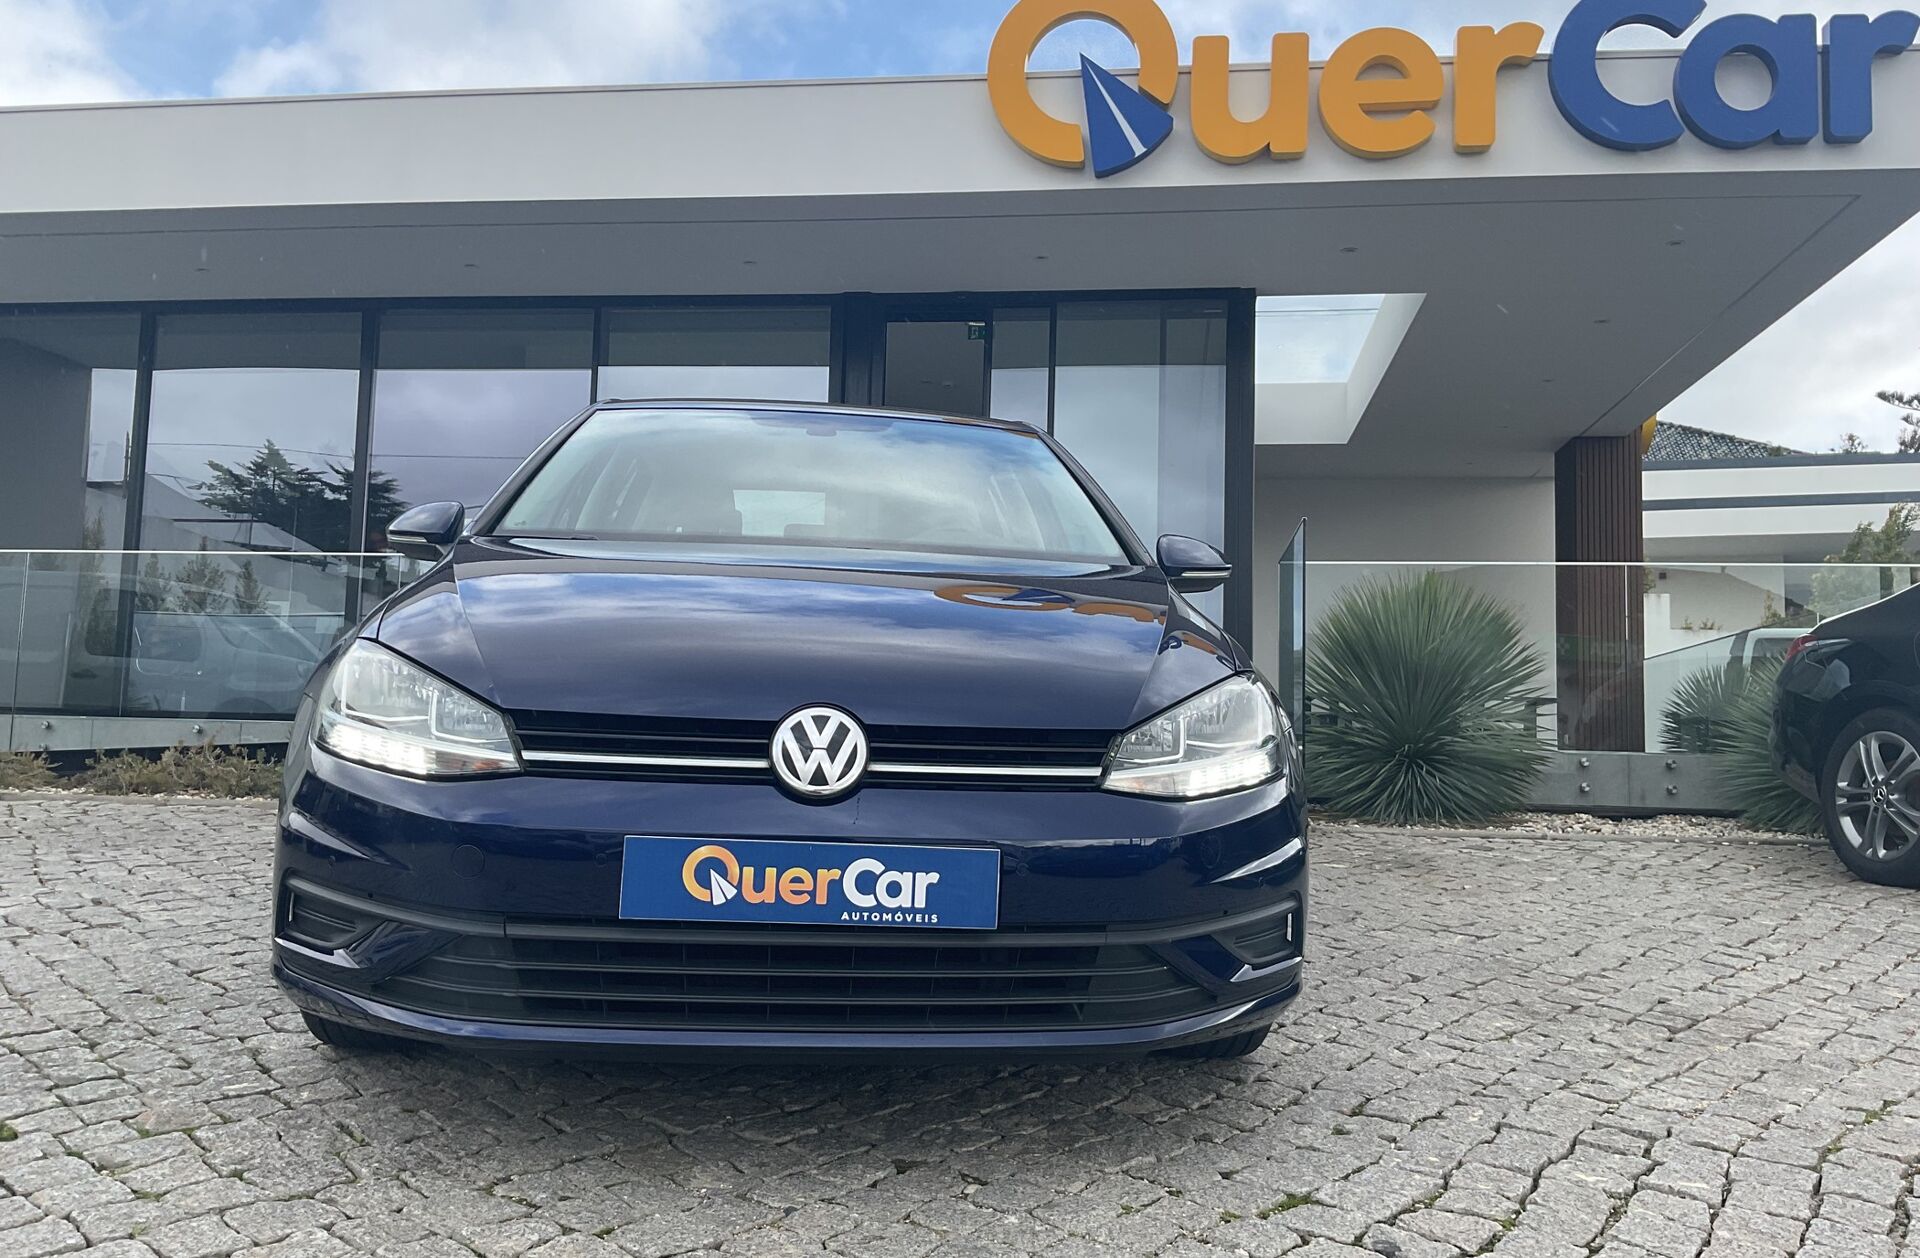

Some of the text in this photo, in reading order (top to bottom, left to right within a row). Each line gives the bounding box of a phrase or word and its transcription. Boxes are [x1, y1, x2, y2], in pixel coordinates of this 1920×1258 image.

[987, 0, 1920, 178] QuerCar
[775, 708, 864, 790] VW
[682, 845, 940, 908] QuerCar
[840, 911, 938, 923] AUTOMÓVEIS
